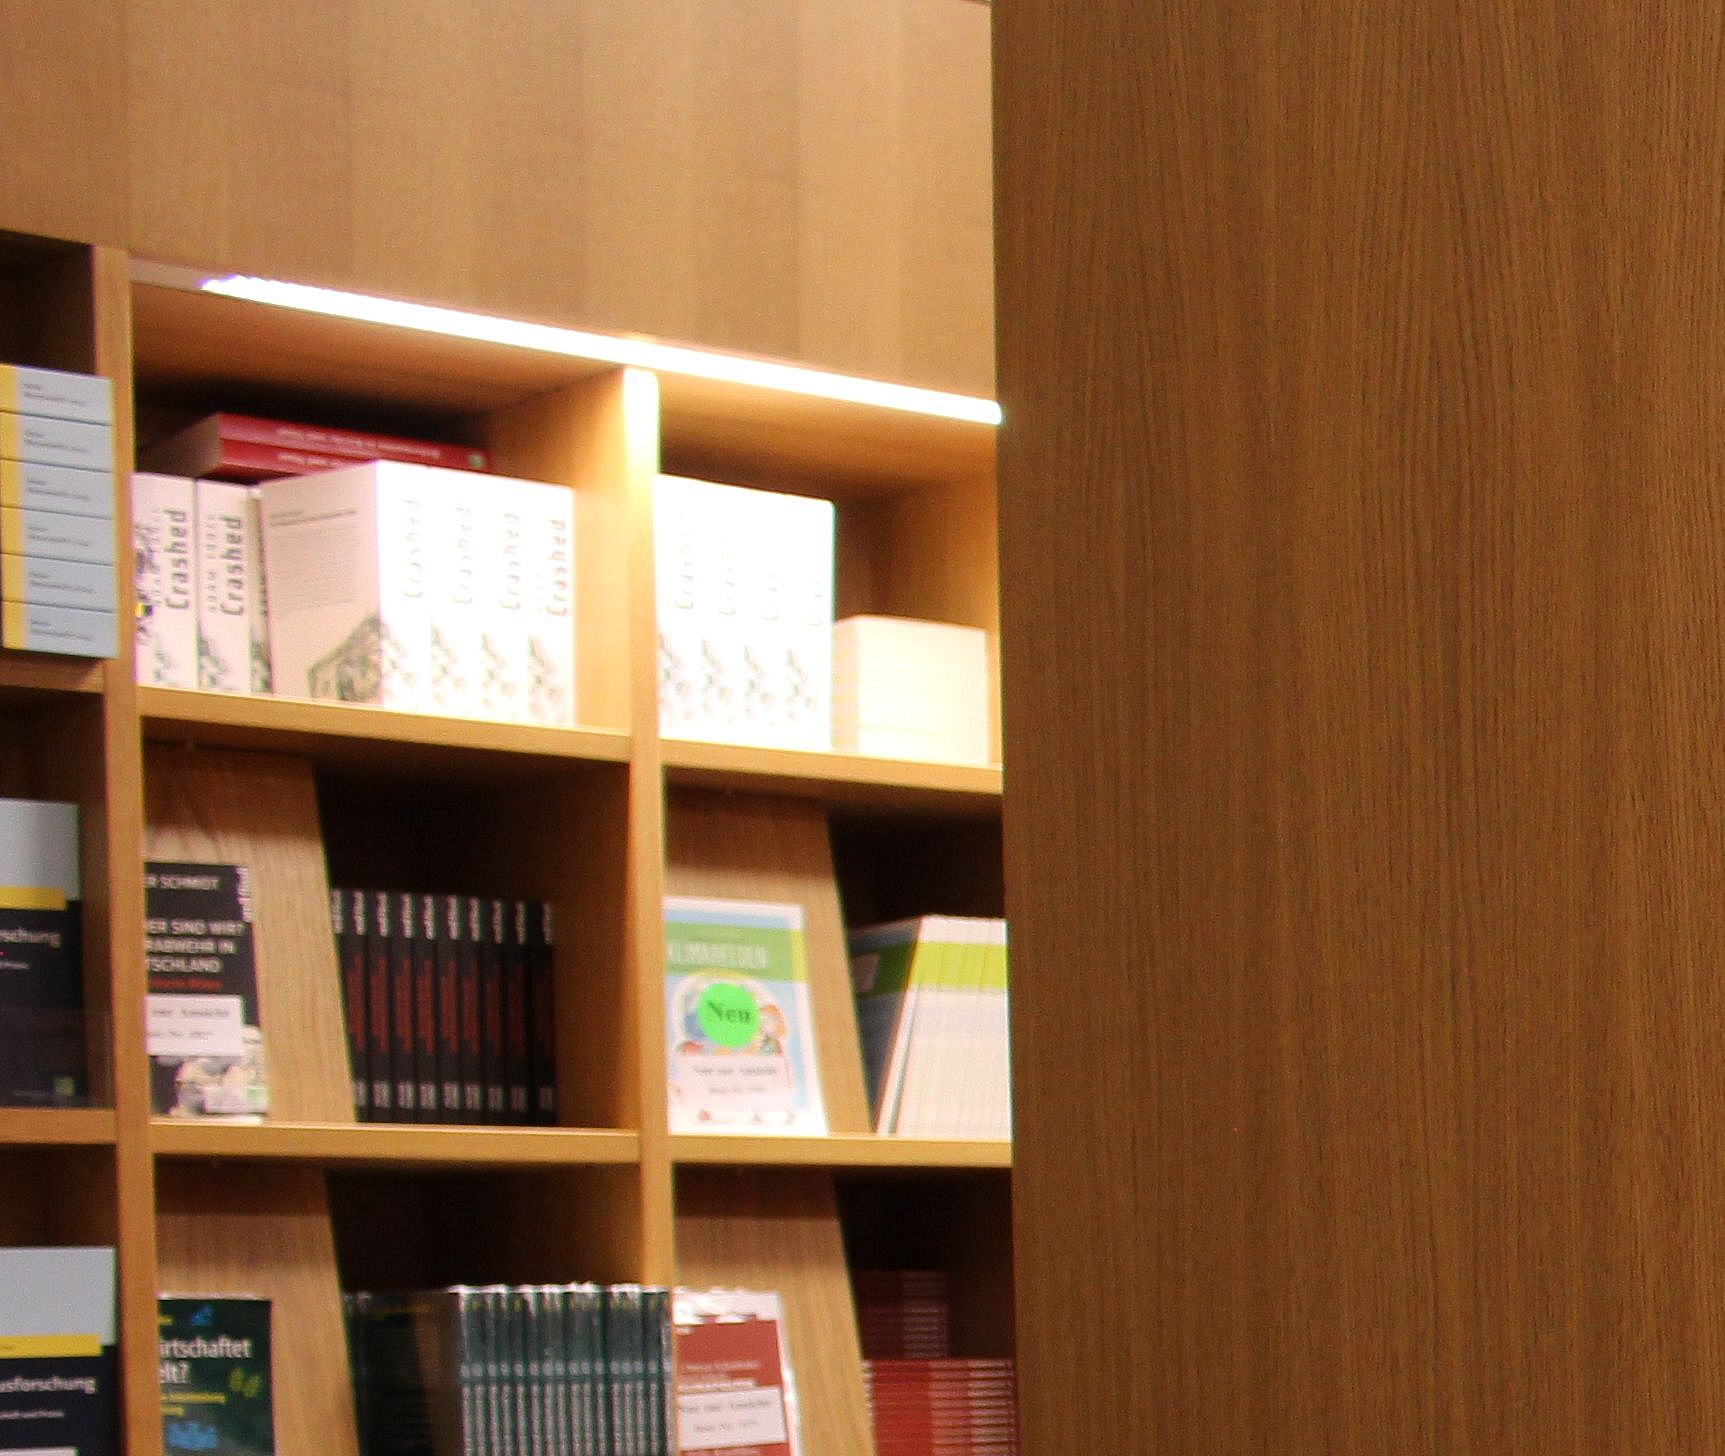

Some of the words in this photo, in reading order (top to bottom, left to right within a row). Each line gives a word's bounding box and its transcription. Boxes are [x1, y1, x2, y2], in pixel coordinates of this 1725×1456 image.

[164, 508, 190, 610] Crashed
[219, 515, 245, 616] Crashed
[707, 1001, 750, 1025] Neu
